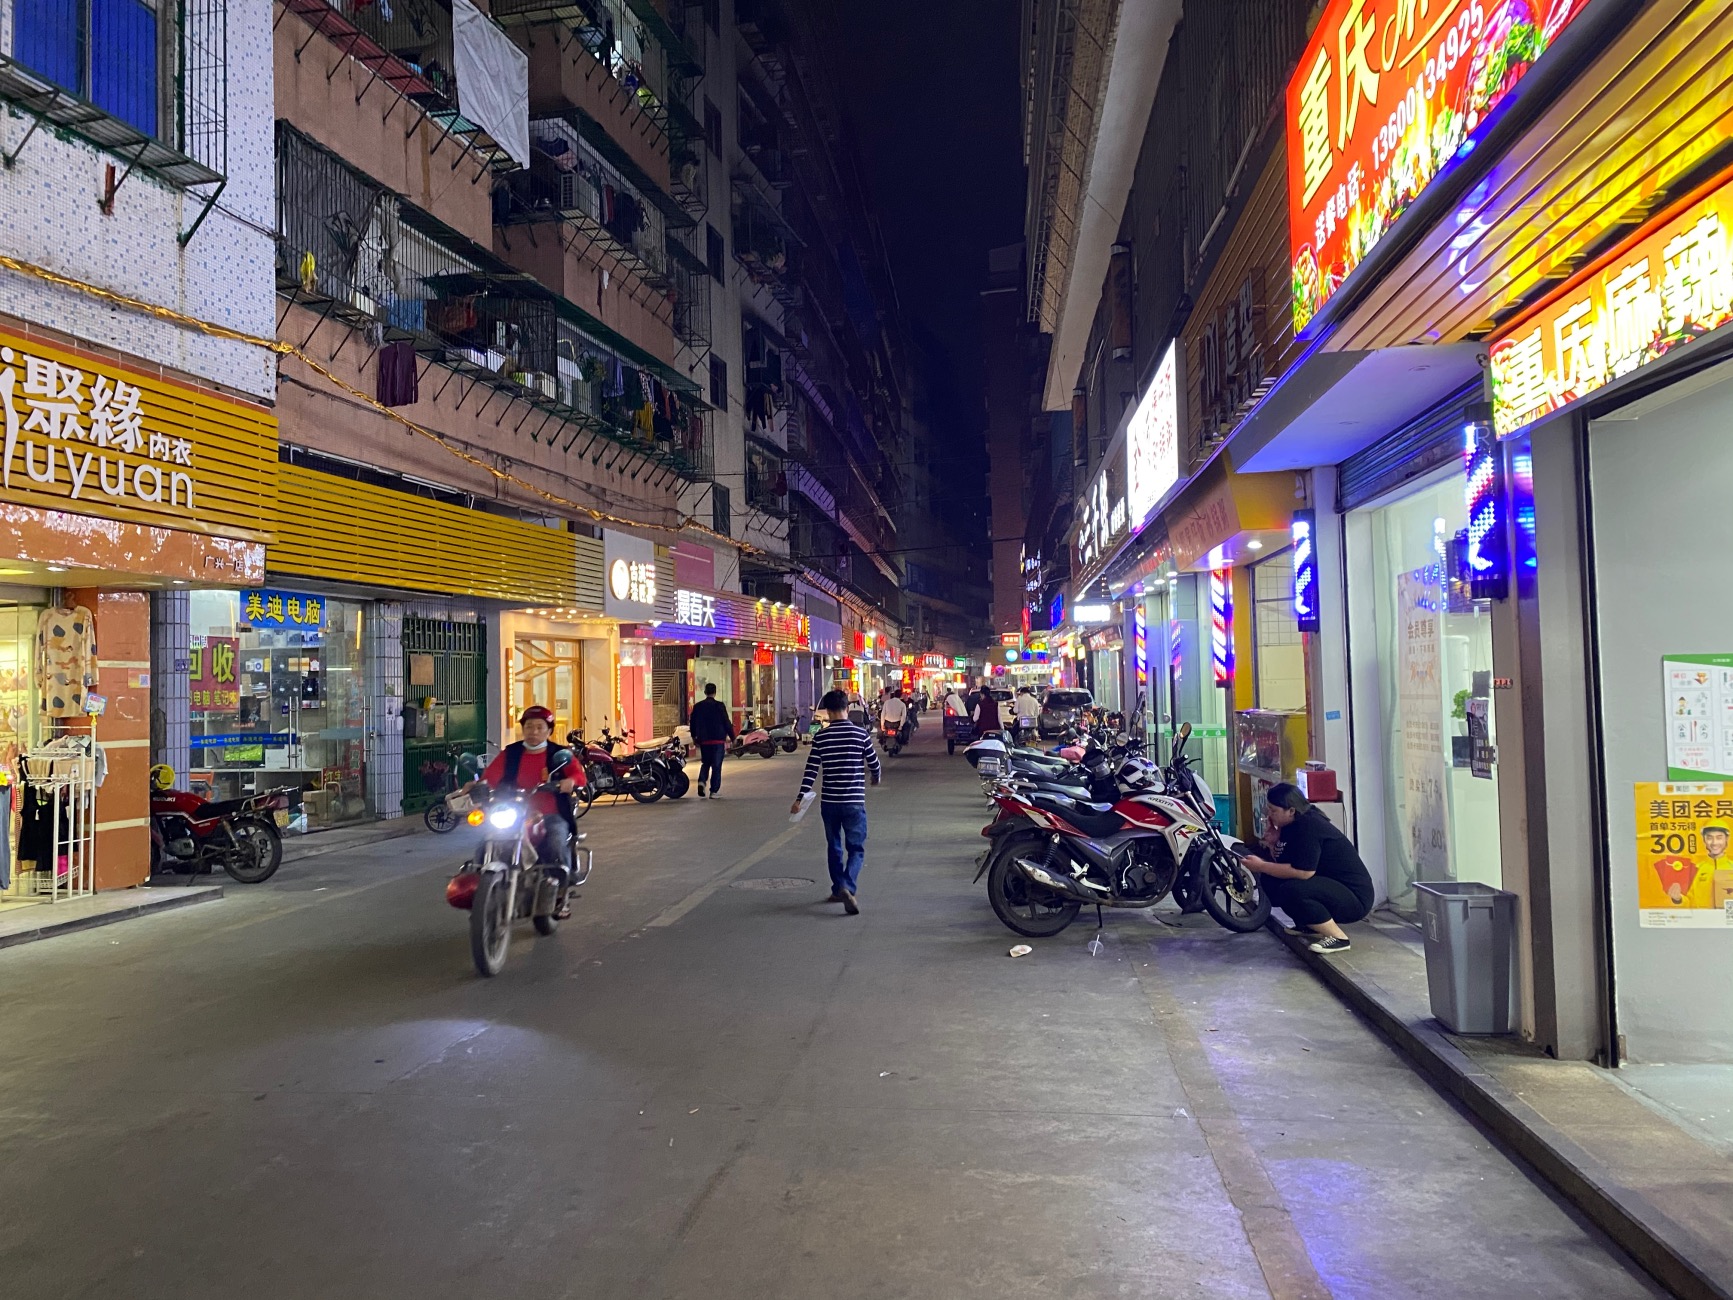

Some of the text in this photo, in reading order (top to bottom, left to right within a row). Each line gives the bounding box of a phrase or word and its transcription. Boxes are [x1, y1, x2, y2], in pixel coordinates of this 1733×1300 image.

[1371, 0, 1484, 171] 13600134925
[149, 432, 192, 467] 内衣
[245, 591, 321, 625] 美迪电脑
[1650, 800, 1733, 819] 美团会员
[1650, 821, 1697, 832] 首单3元得
[1650, 833, 1686, 855] 30
